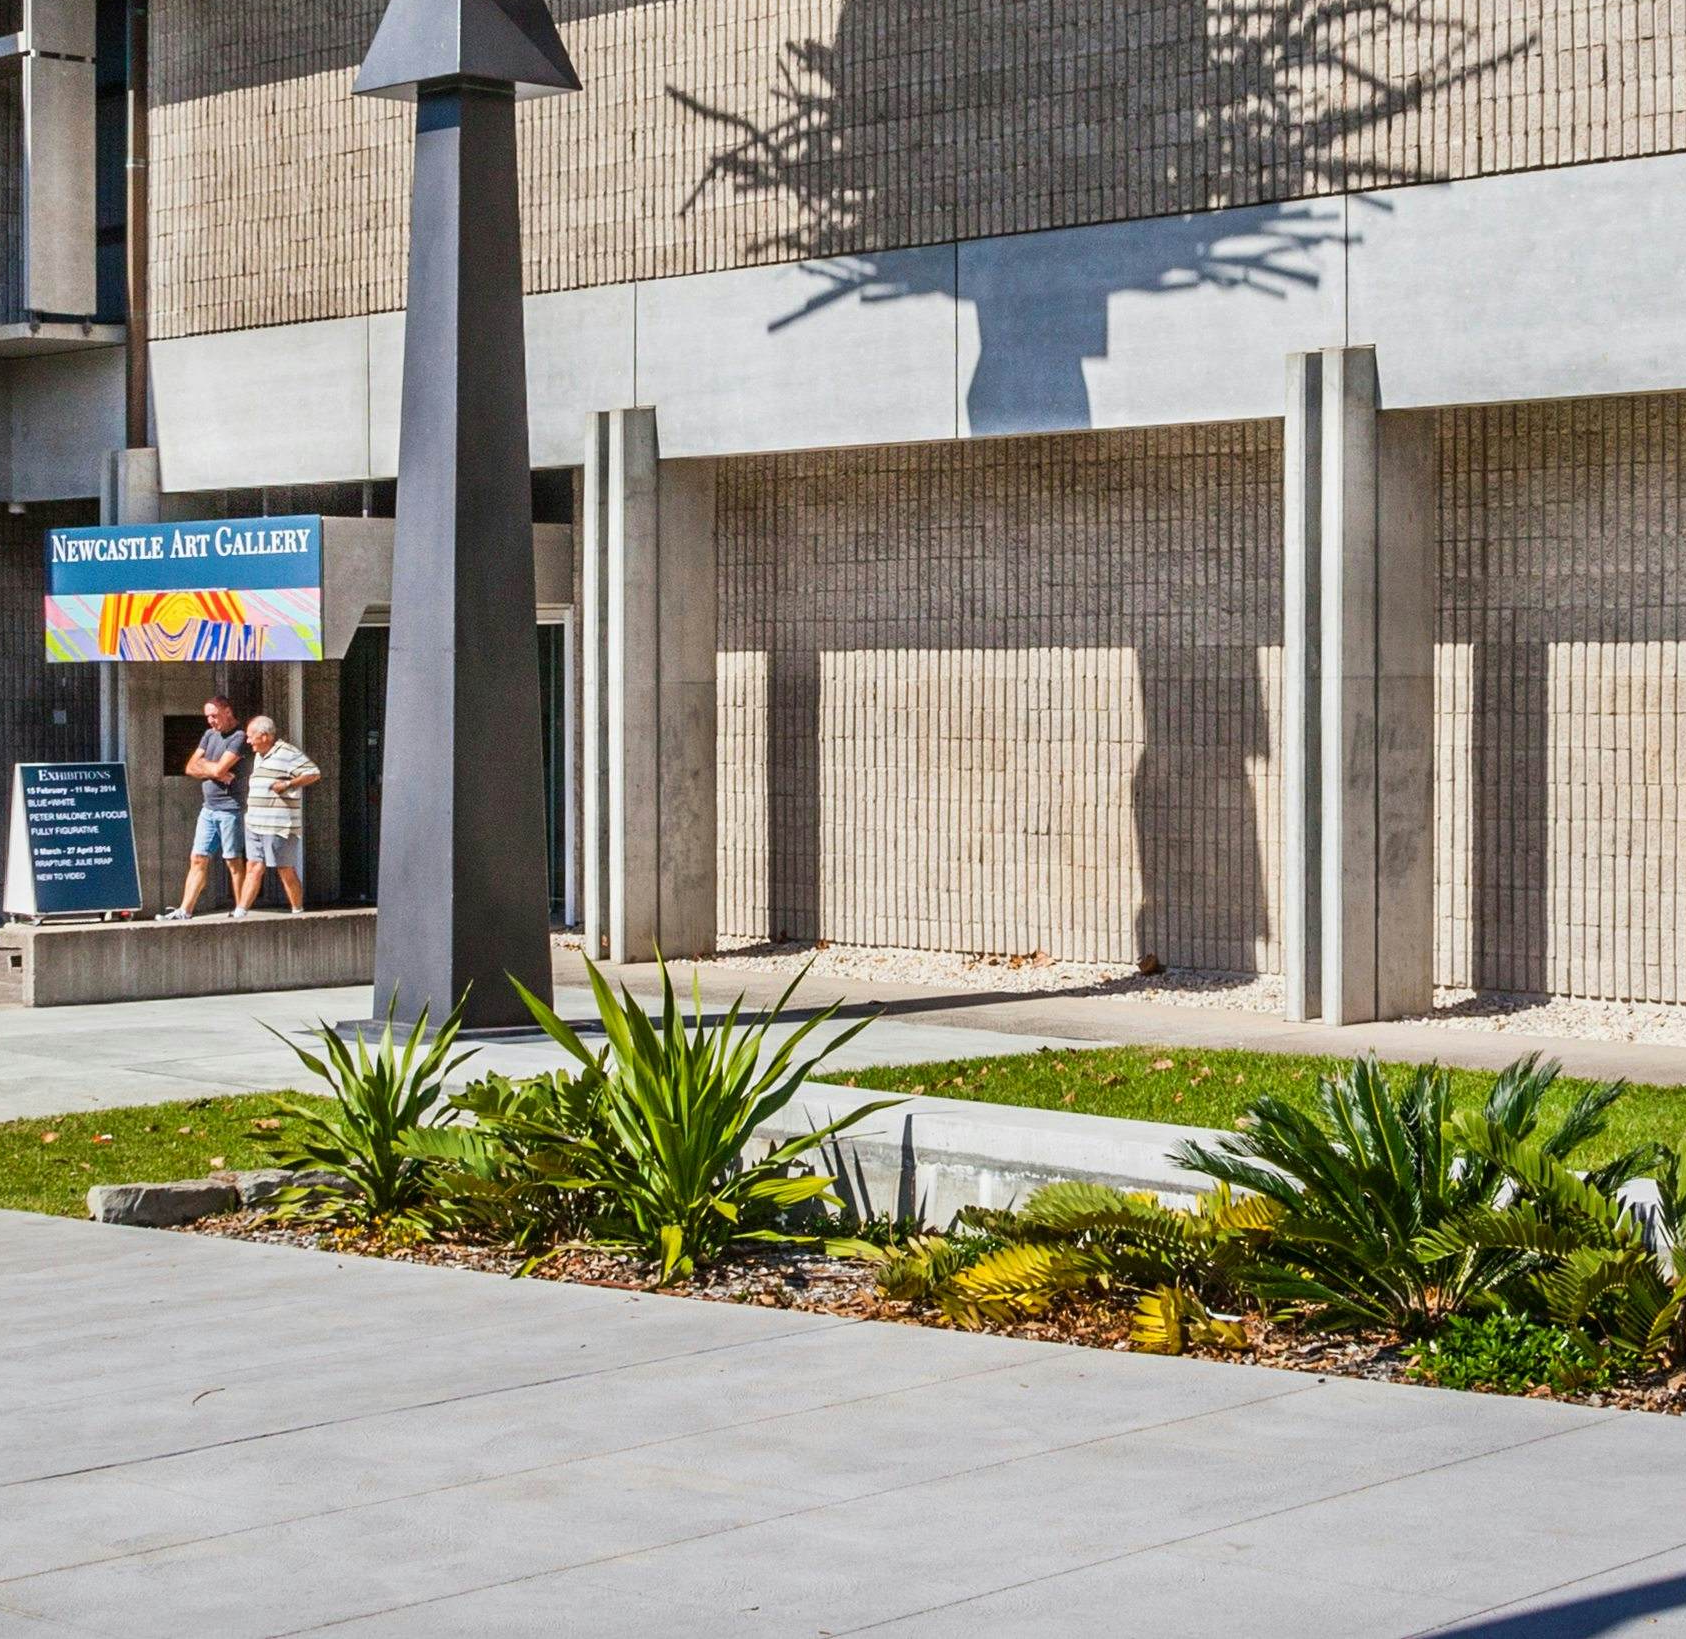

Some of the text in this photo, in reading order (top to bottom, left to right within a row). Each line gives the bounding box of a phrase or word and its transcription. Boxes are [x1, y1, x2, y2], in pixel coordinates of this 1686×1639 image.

[51, 526, 311, 563] NEWCASTLE ART GALLERY
[38, 769, 112, 782] EXHIBITIONS
[37, 786, 68, 795] February
[84, 786, 98, 794] May
[29, 812, 54, 821] PETER
[94, 811, 101, 819] A
[101, 810, 128, 819] FOCUS
[30, 825, 100, 836] FULLY FIGURATIVE
[39, 847, 62, 855] March
[66, 846, 75, 854] 27
[76, 846, 93, 855] April
[94, 845, 112, 853] 2014
[75, 858, 93, 866] JULIE
[36, 872, 86, 881] NEW TO VIDEO
